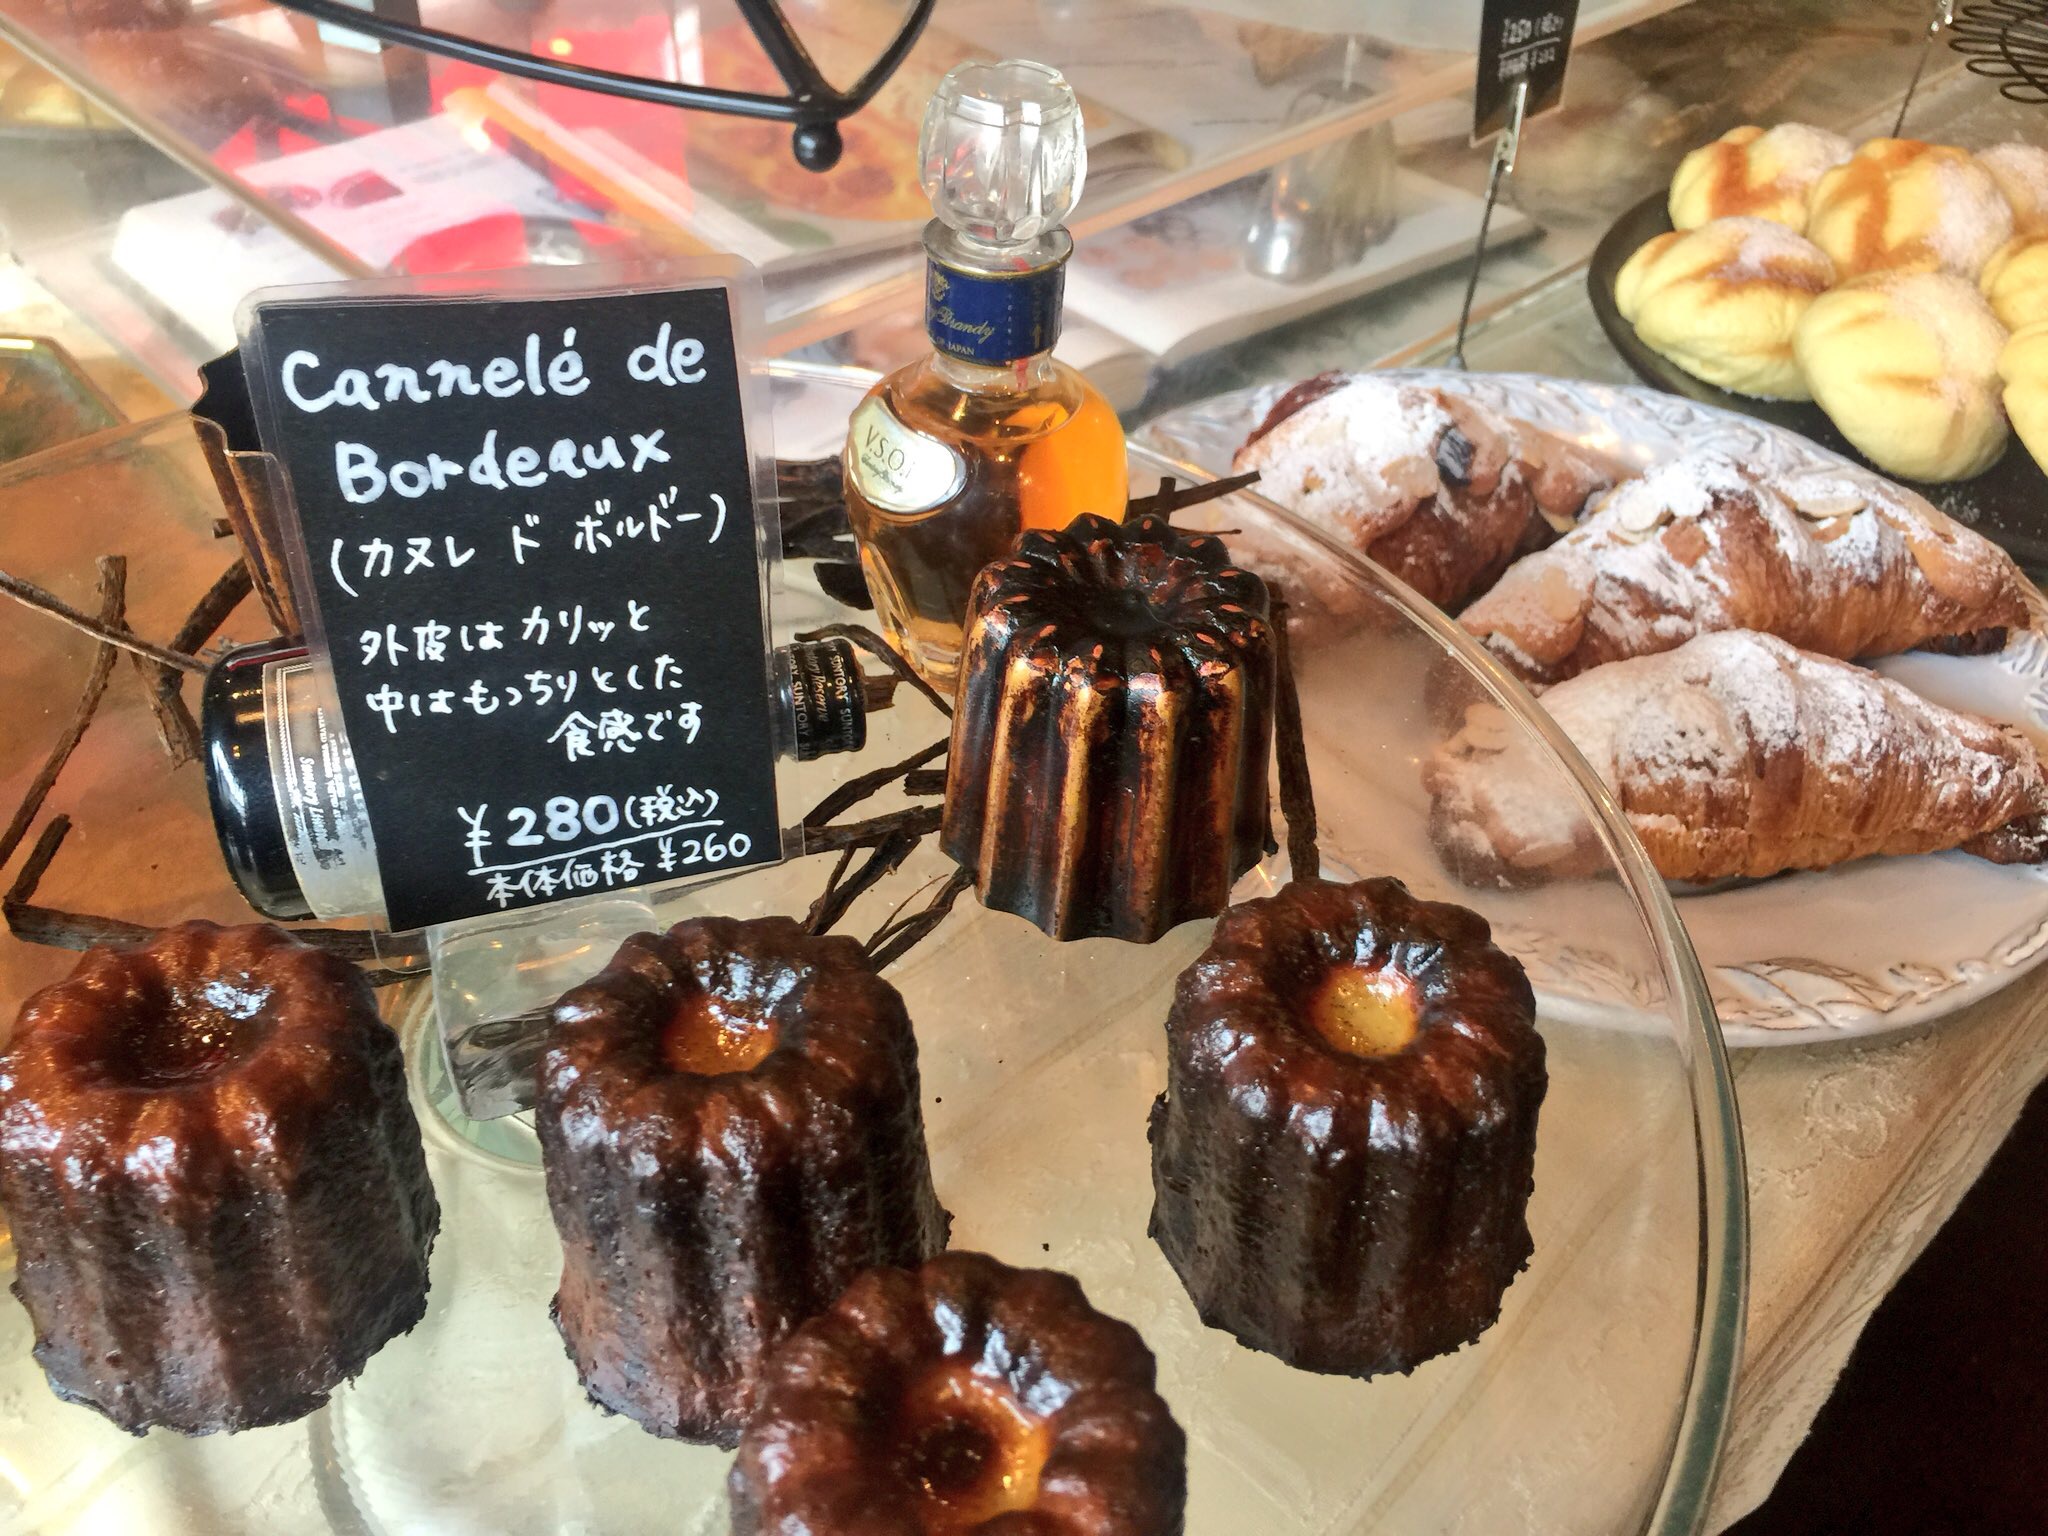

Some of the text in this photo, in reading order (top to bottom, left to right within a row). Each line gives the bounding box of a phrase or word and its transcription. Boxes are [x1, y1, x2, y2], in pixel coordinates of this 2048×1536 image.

[938, 306, 995, 344] Brandy
[948, 341, 975, 356] JAPAN
[282, 322, 707, 412] Cannelé de
[335, 429, 671, 504] Bordeaux
[330, 486, 727, 597] (カヌレ ド ボルドー)
[811, 675, 829, 722] Reserve
[831, 655, 849, 702] SUNTORY
[547, 701, 702, 762] 食感です
[792, 680, 810, 736] SUNTORY
[657, 832, 752, 873] ¥260
